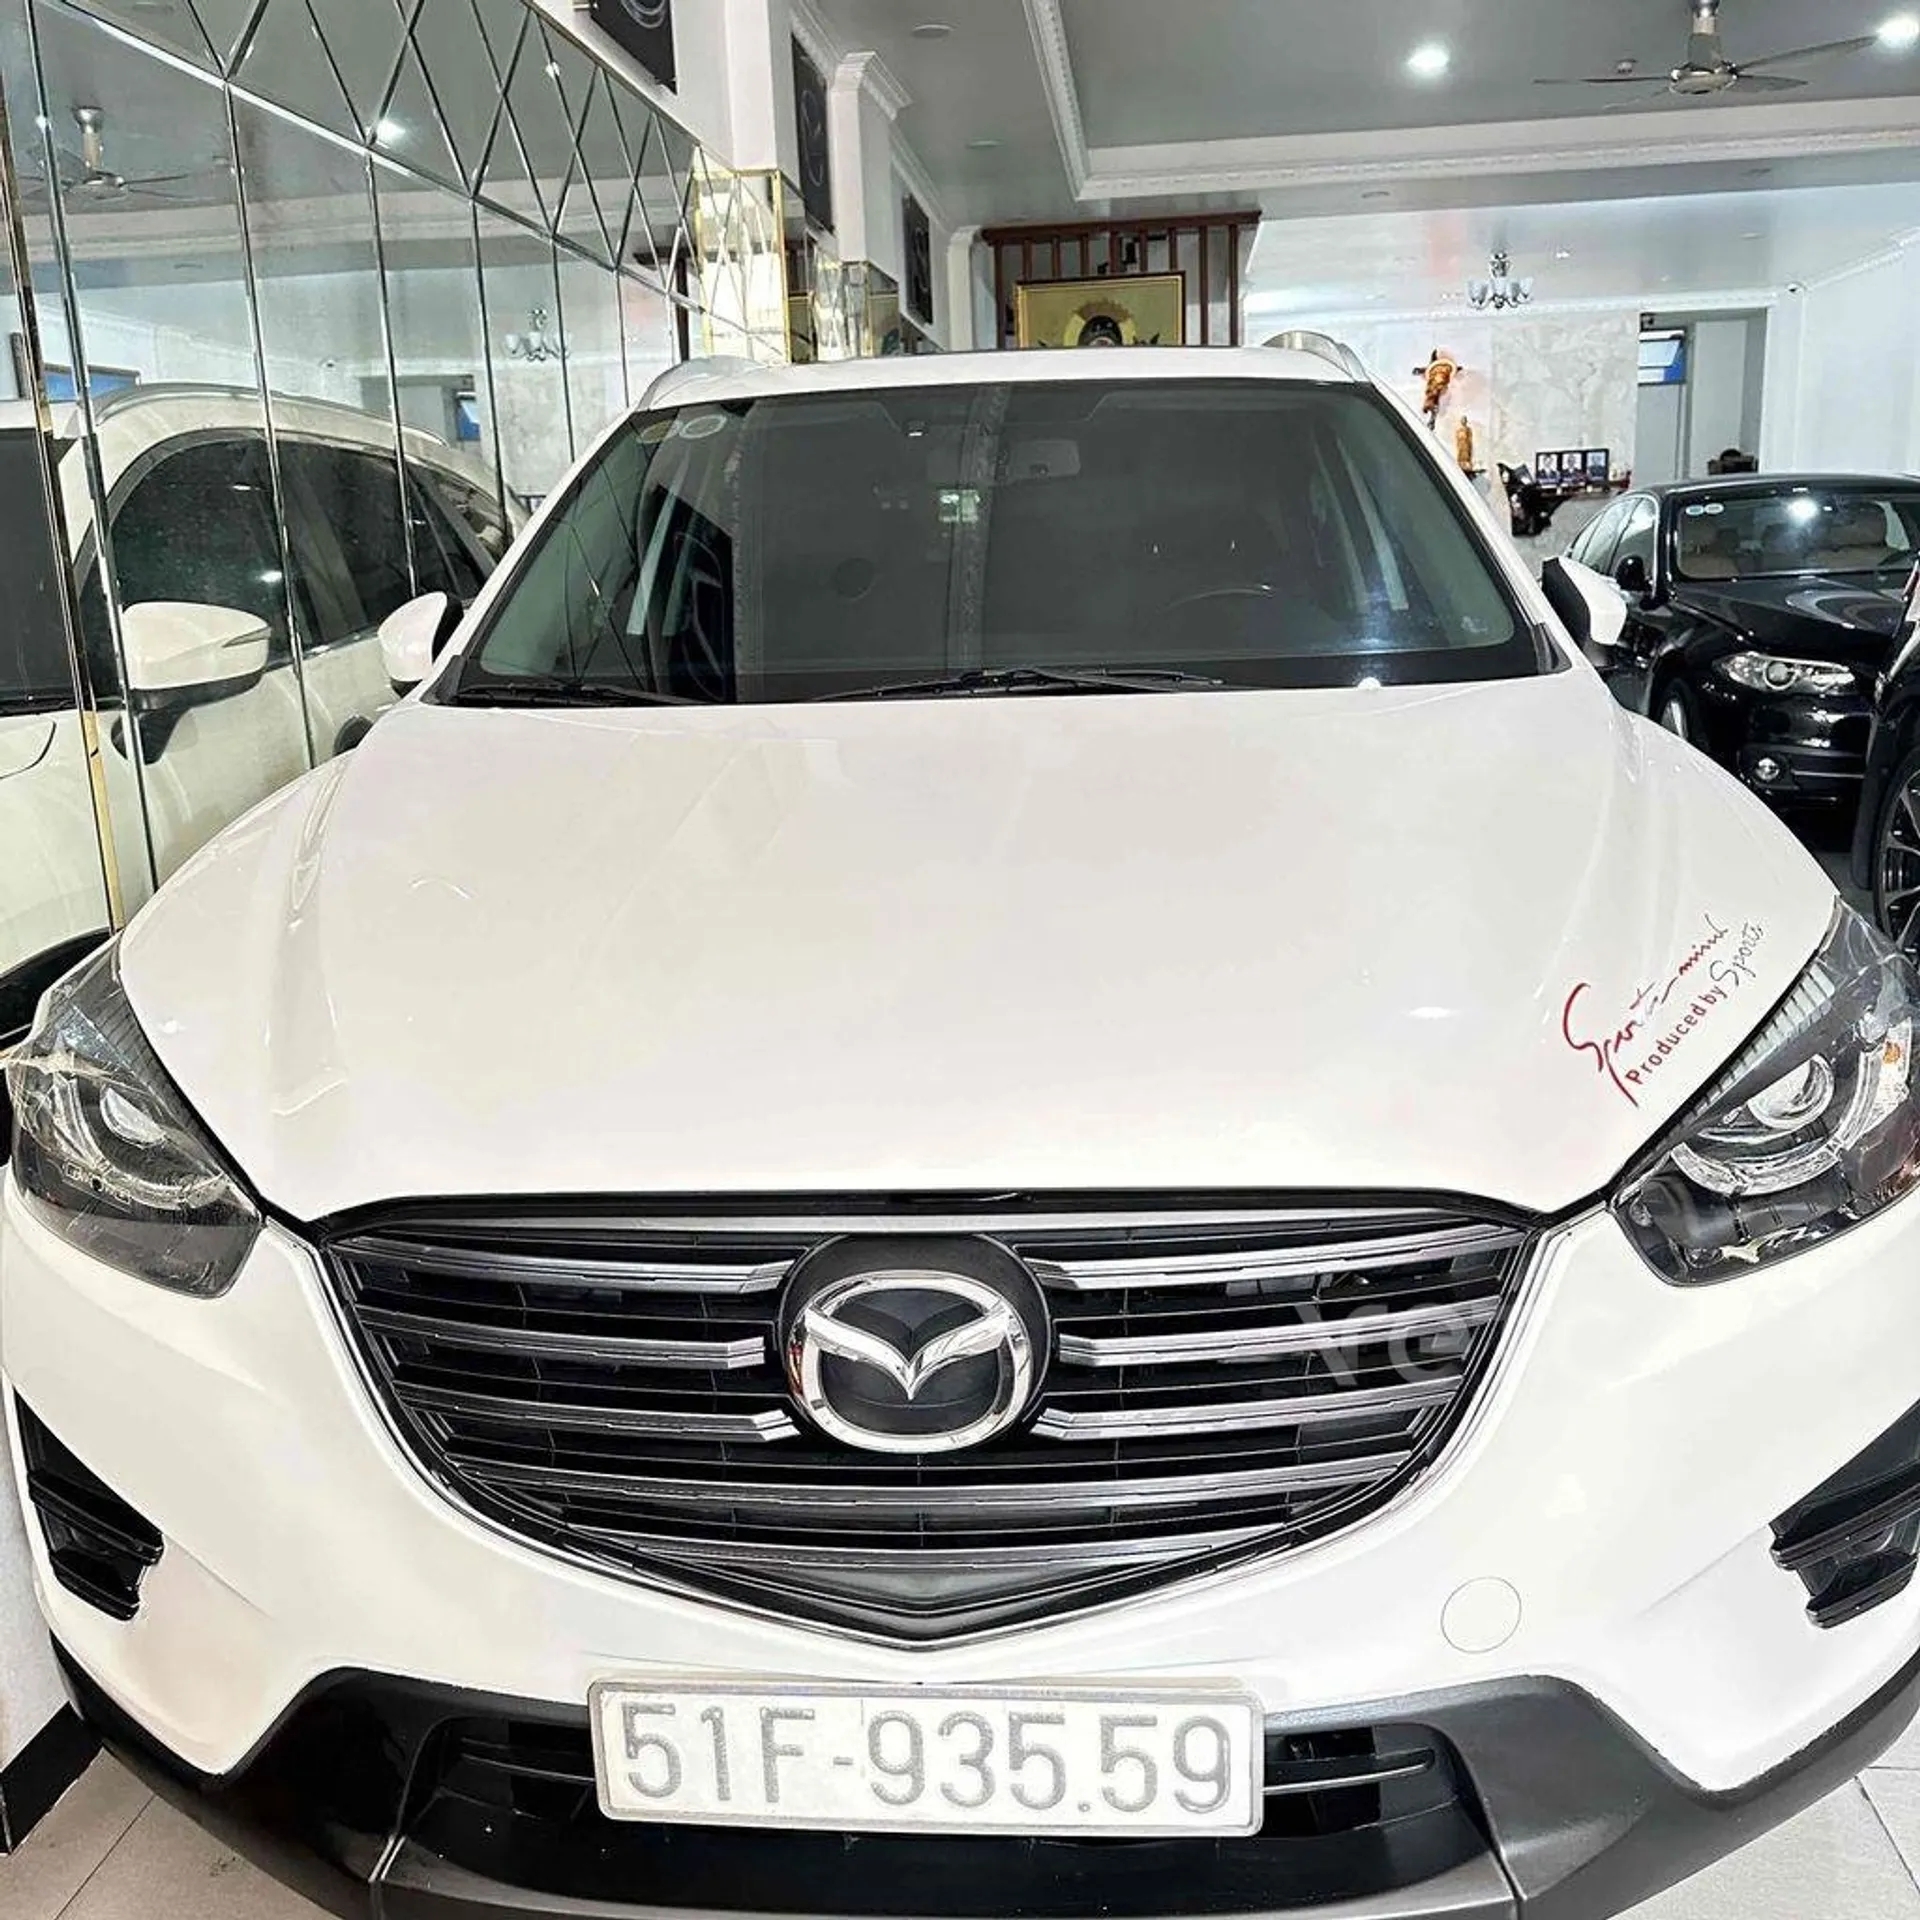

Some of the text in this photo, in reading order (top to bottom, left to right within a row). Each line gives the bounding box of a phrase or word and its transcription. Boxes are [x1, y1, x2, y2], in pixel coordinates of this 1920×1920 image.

[1624, 1002, 1708, 1085] Produced
[1697, 984, 1729, 1005] by
[621, 1701, 1231, 1813] 51F-935.59
